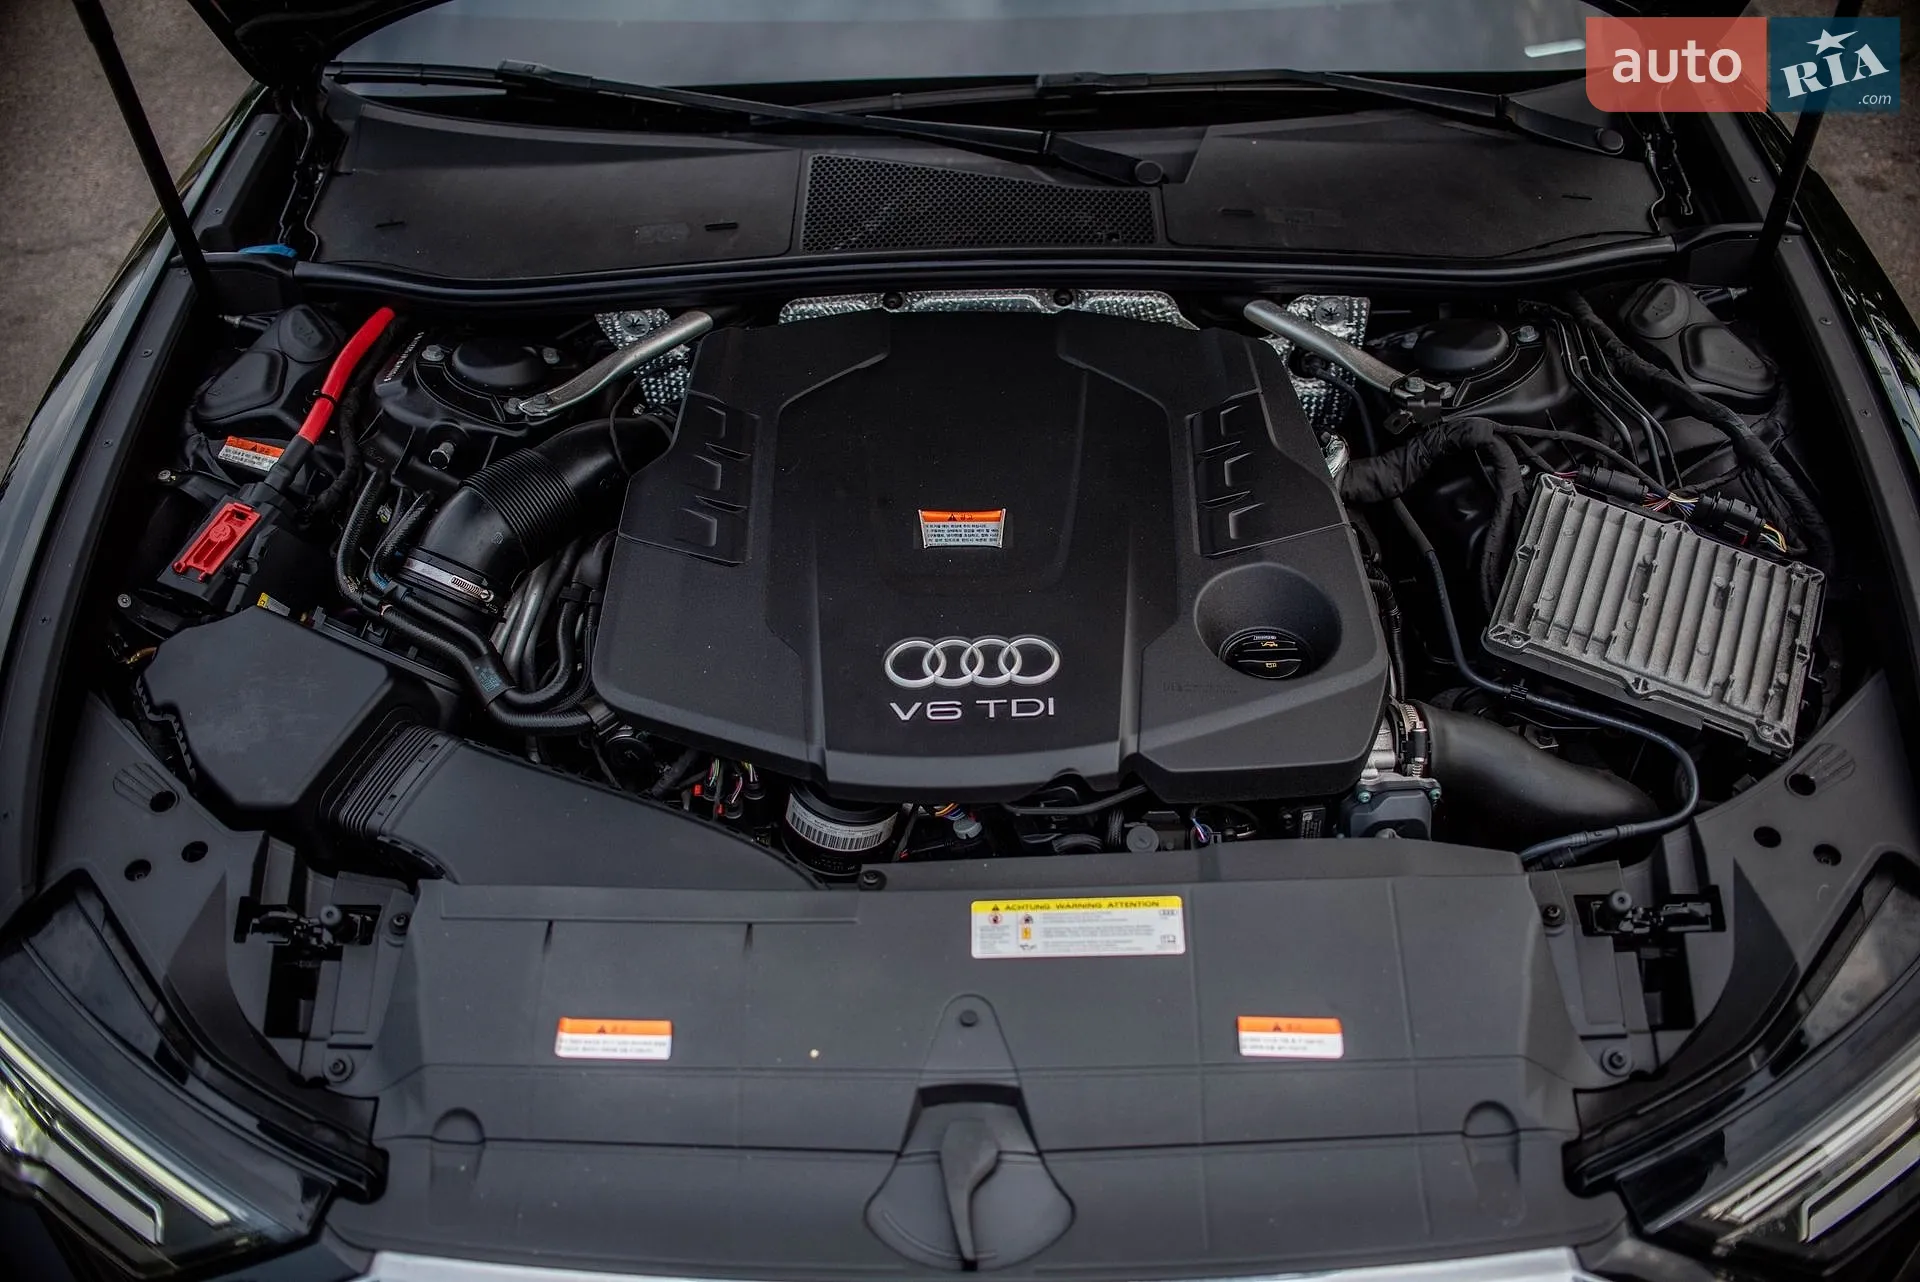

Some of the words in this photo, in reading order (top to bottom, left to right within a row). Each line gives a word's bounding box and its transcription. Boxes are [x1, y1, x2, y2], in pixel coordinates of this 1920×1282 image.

[889, 701, 963, 721] V6
[976, 697, 1055, 719] TDI
[1107, 901, 1160, 909] ATTENTION
